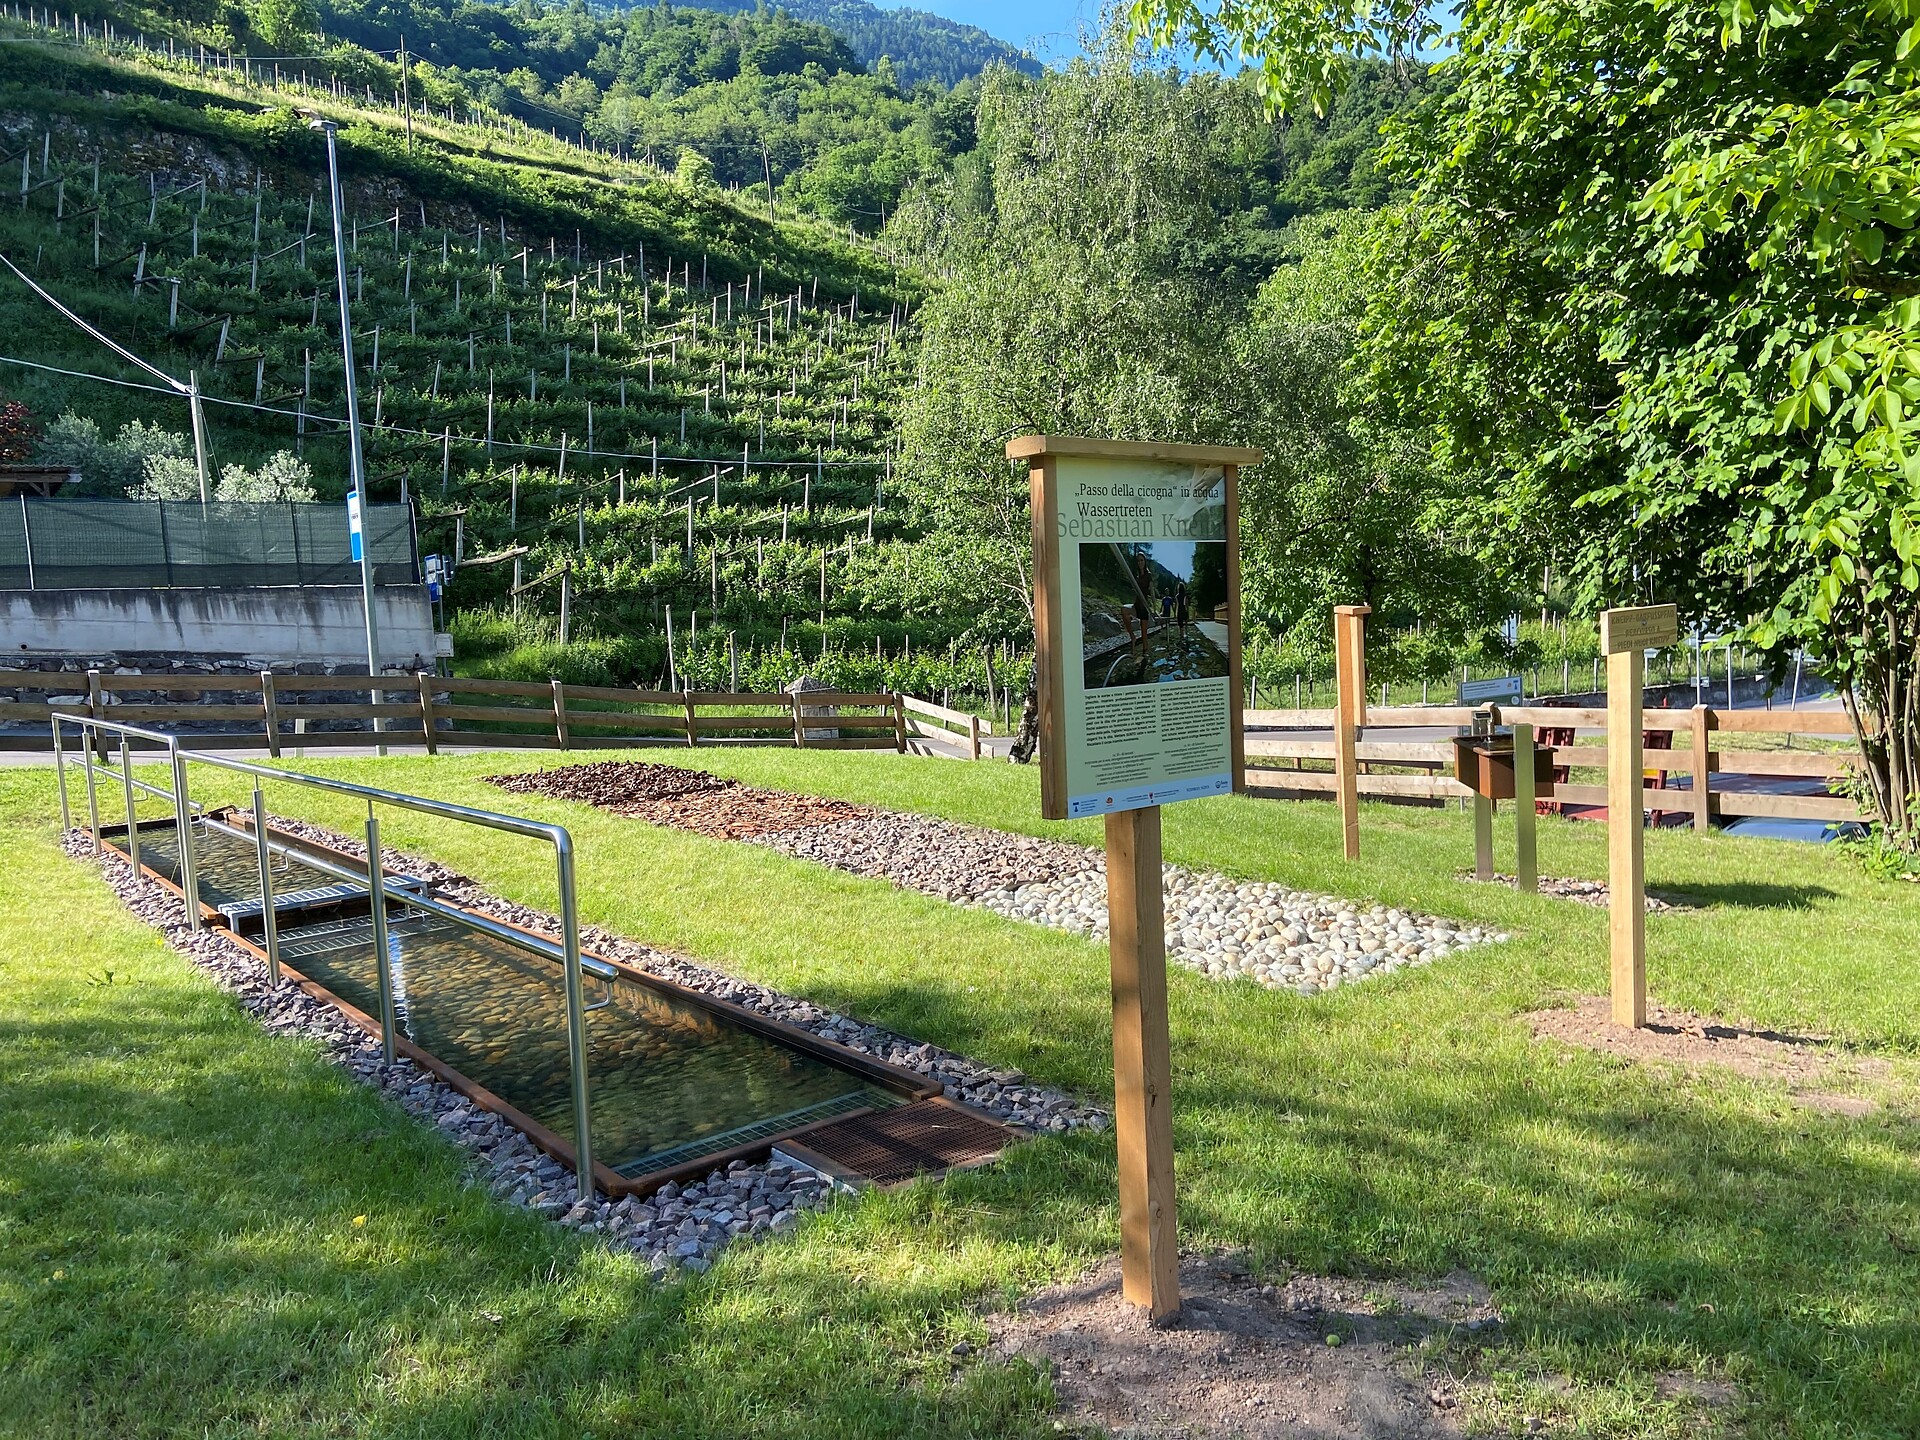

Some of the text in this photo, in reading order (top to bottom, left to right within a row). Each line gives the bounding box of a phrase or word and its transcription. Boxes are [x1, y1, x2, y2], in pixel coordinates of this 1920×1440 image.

[1075, 482, 1219, 501] „Passo della cicogna“ in acqua
[1077, 502, 1153, 517] Wassertreten
[1057, 512, 1154, 538] Sebastian
